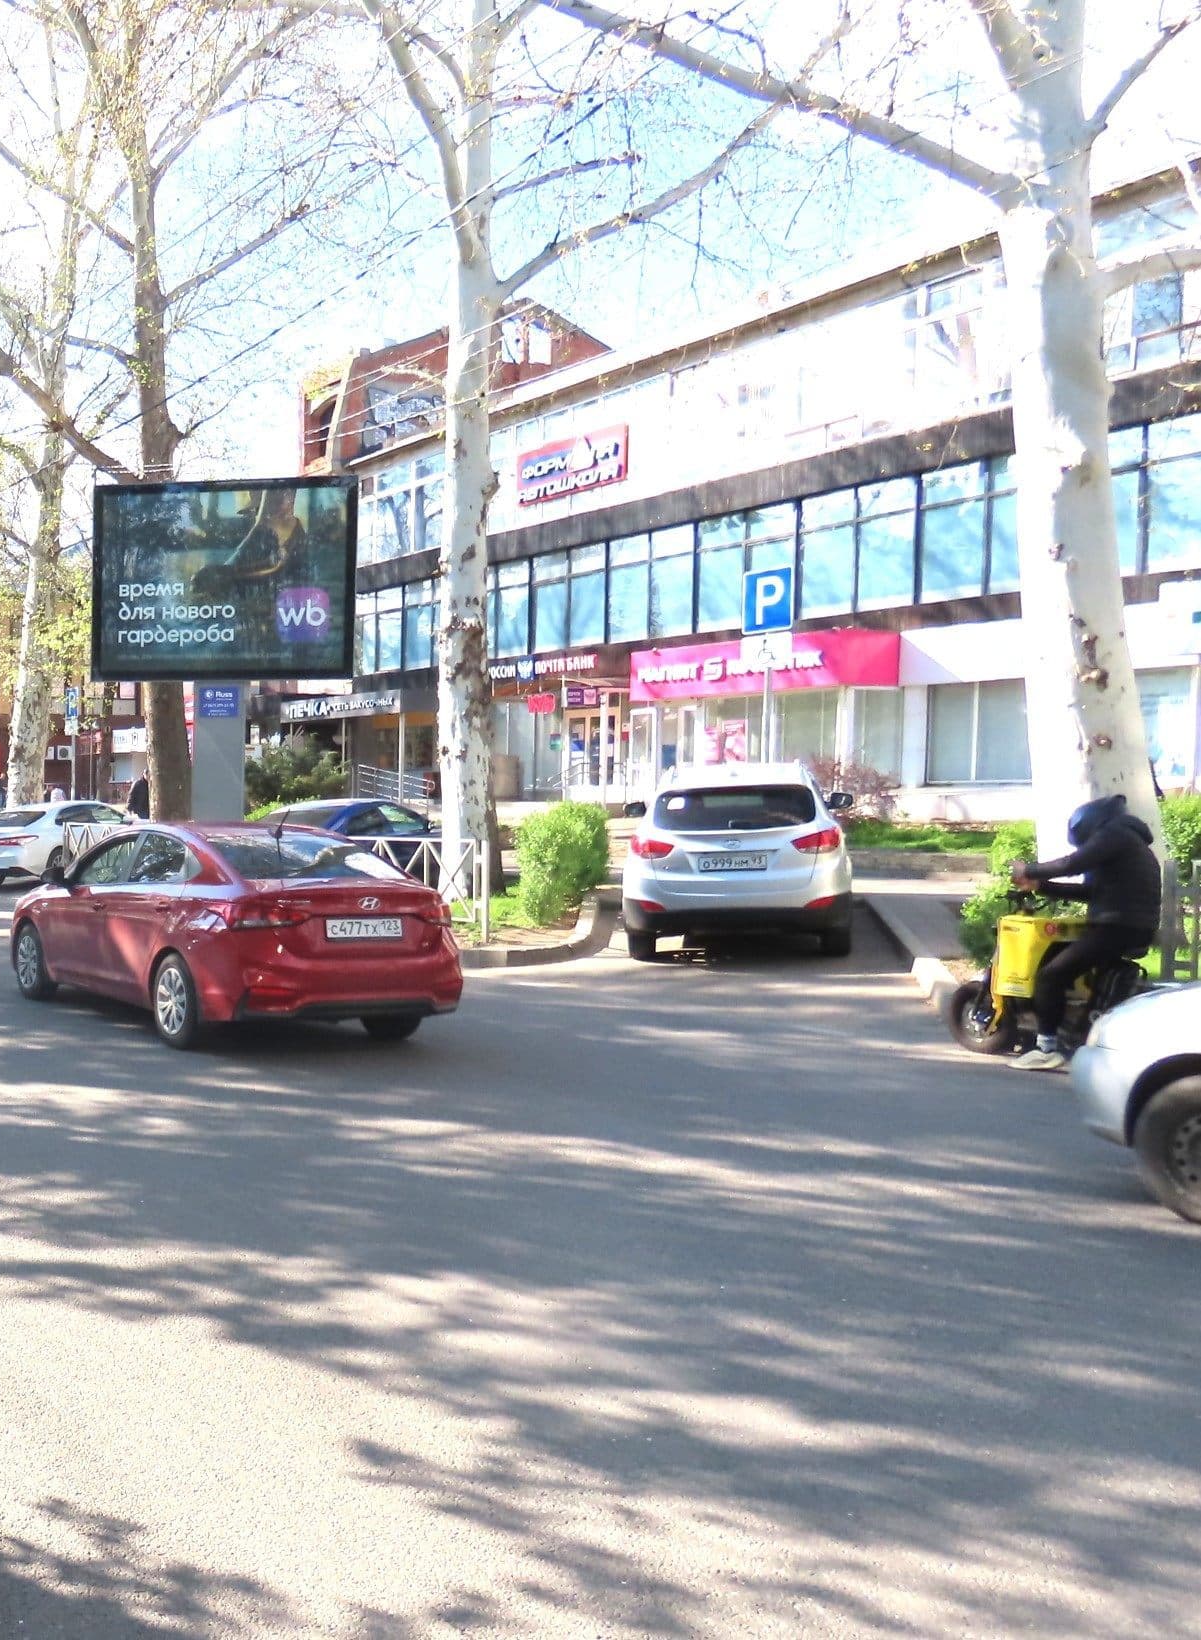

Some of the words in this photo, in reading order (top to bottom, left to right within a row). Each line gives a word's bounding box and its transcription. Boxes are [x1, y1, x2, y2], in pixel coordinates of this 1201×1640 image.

[118, 582, 184, 601] время
[755, 576, 784, 625] P
[118, 603, 155, 620] для
[162, 604, 236, 620] нового
[279, 598, 327, 627] wb
[118, 624, 235, 647] гардероба
[489, 665, 516, 679] ОССИИ
[535, 658, 566, 674] ПОЧТА
[566, 655, 595, 671] БАНК
